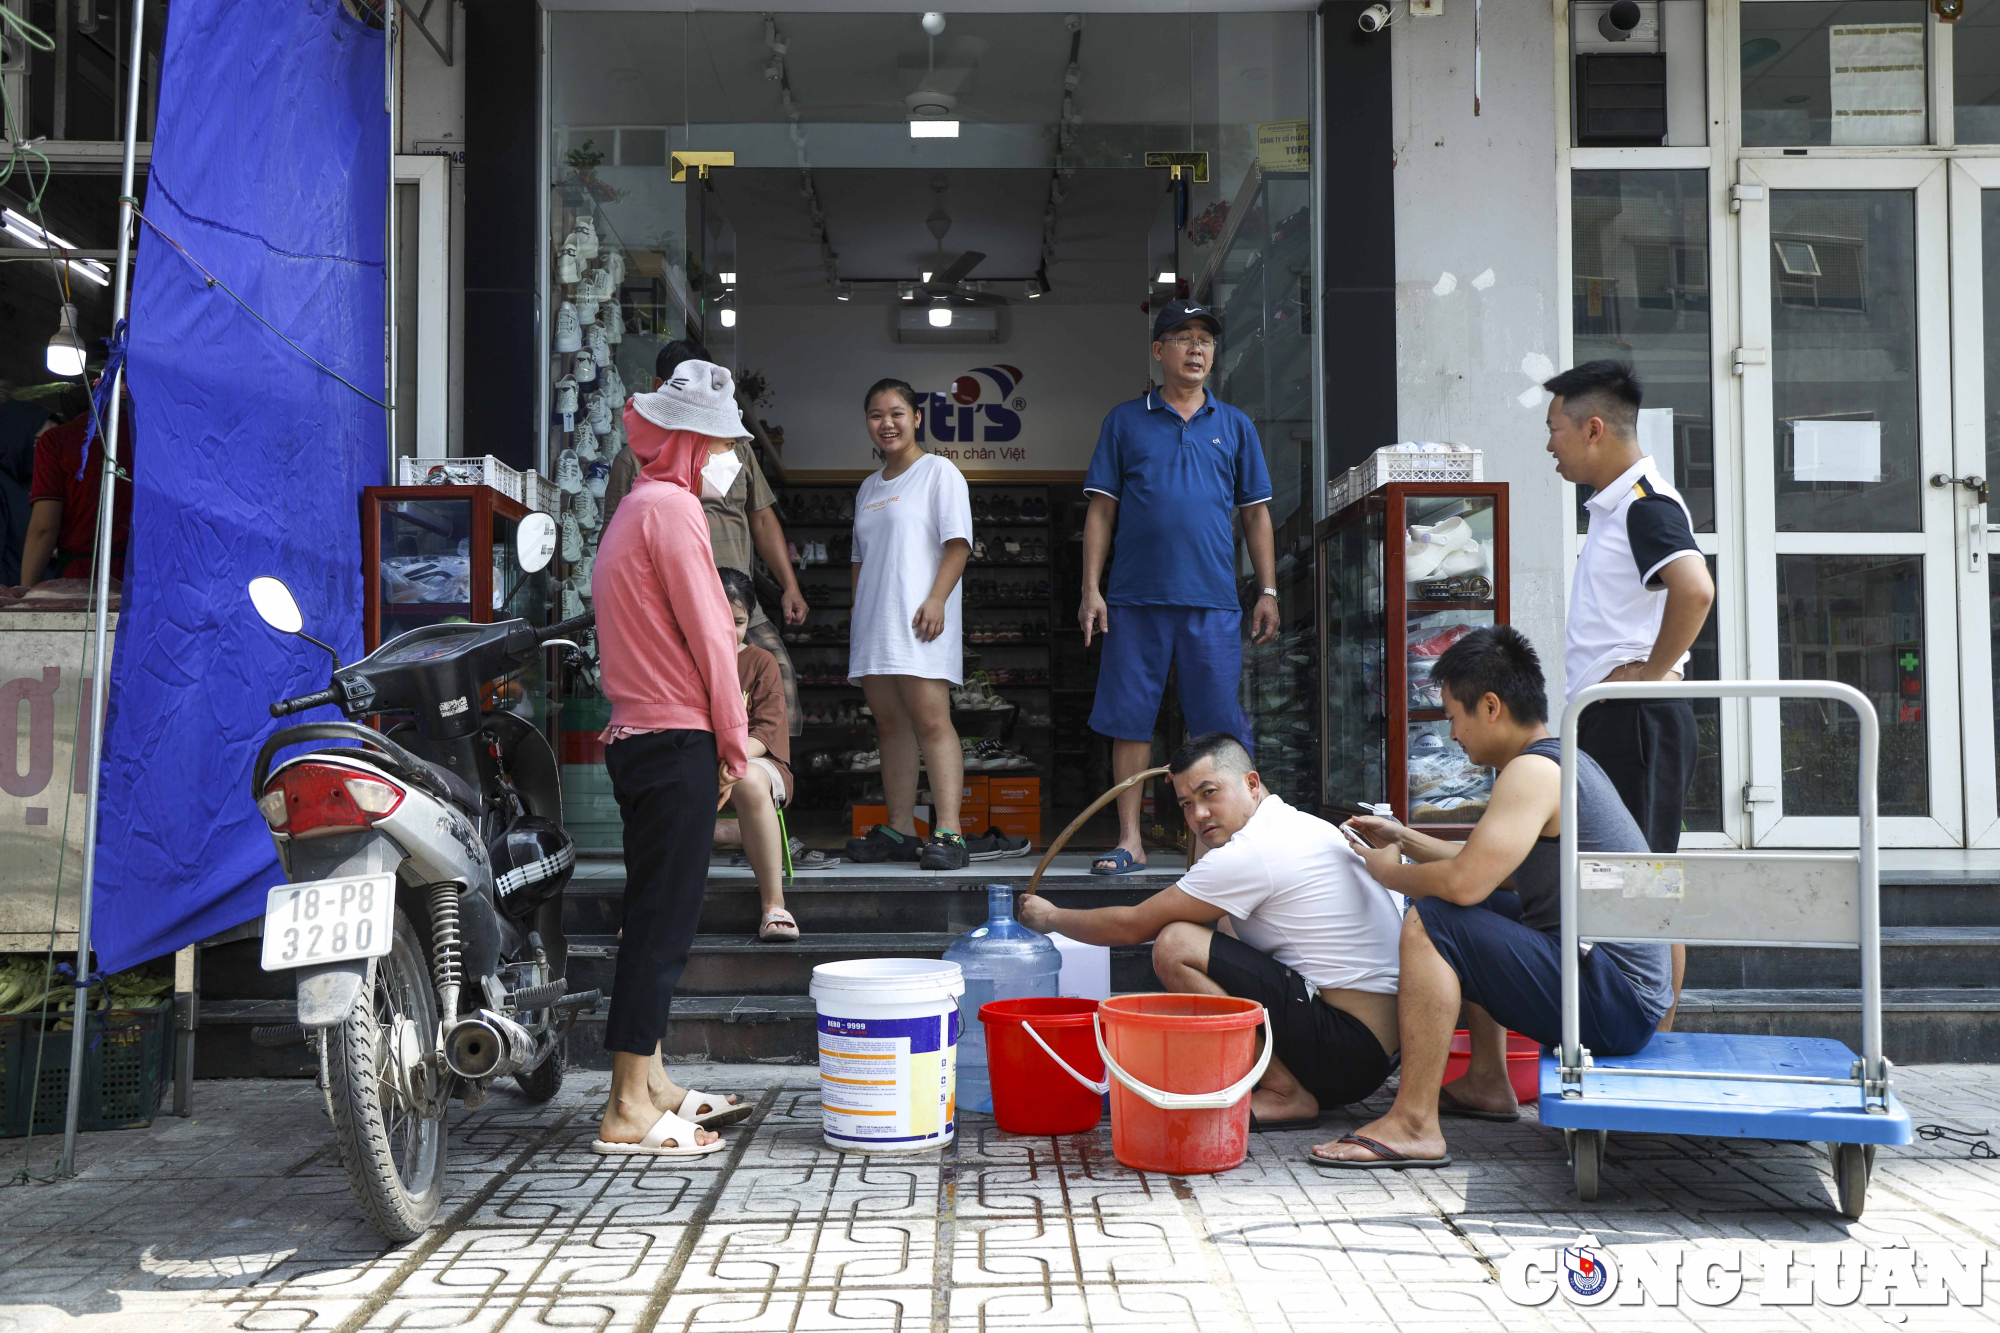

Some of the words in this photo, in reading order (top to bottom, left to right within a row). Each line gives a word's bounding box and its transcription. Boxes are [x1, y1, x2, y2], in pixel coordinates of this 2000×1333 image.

[963, 447, 996, 460] chân
[1000, 447, 1026, 462] Việt
[289, 882, 374, 922] 18-P8
[281, 918, 373, 960] 3280
